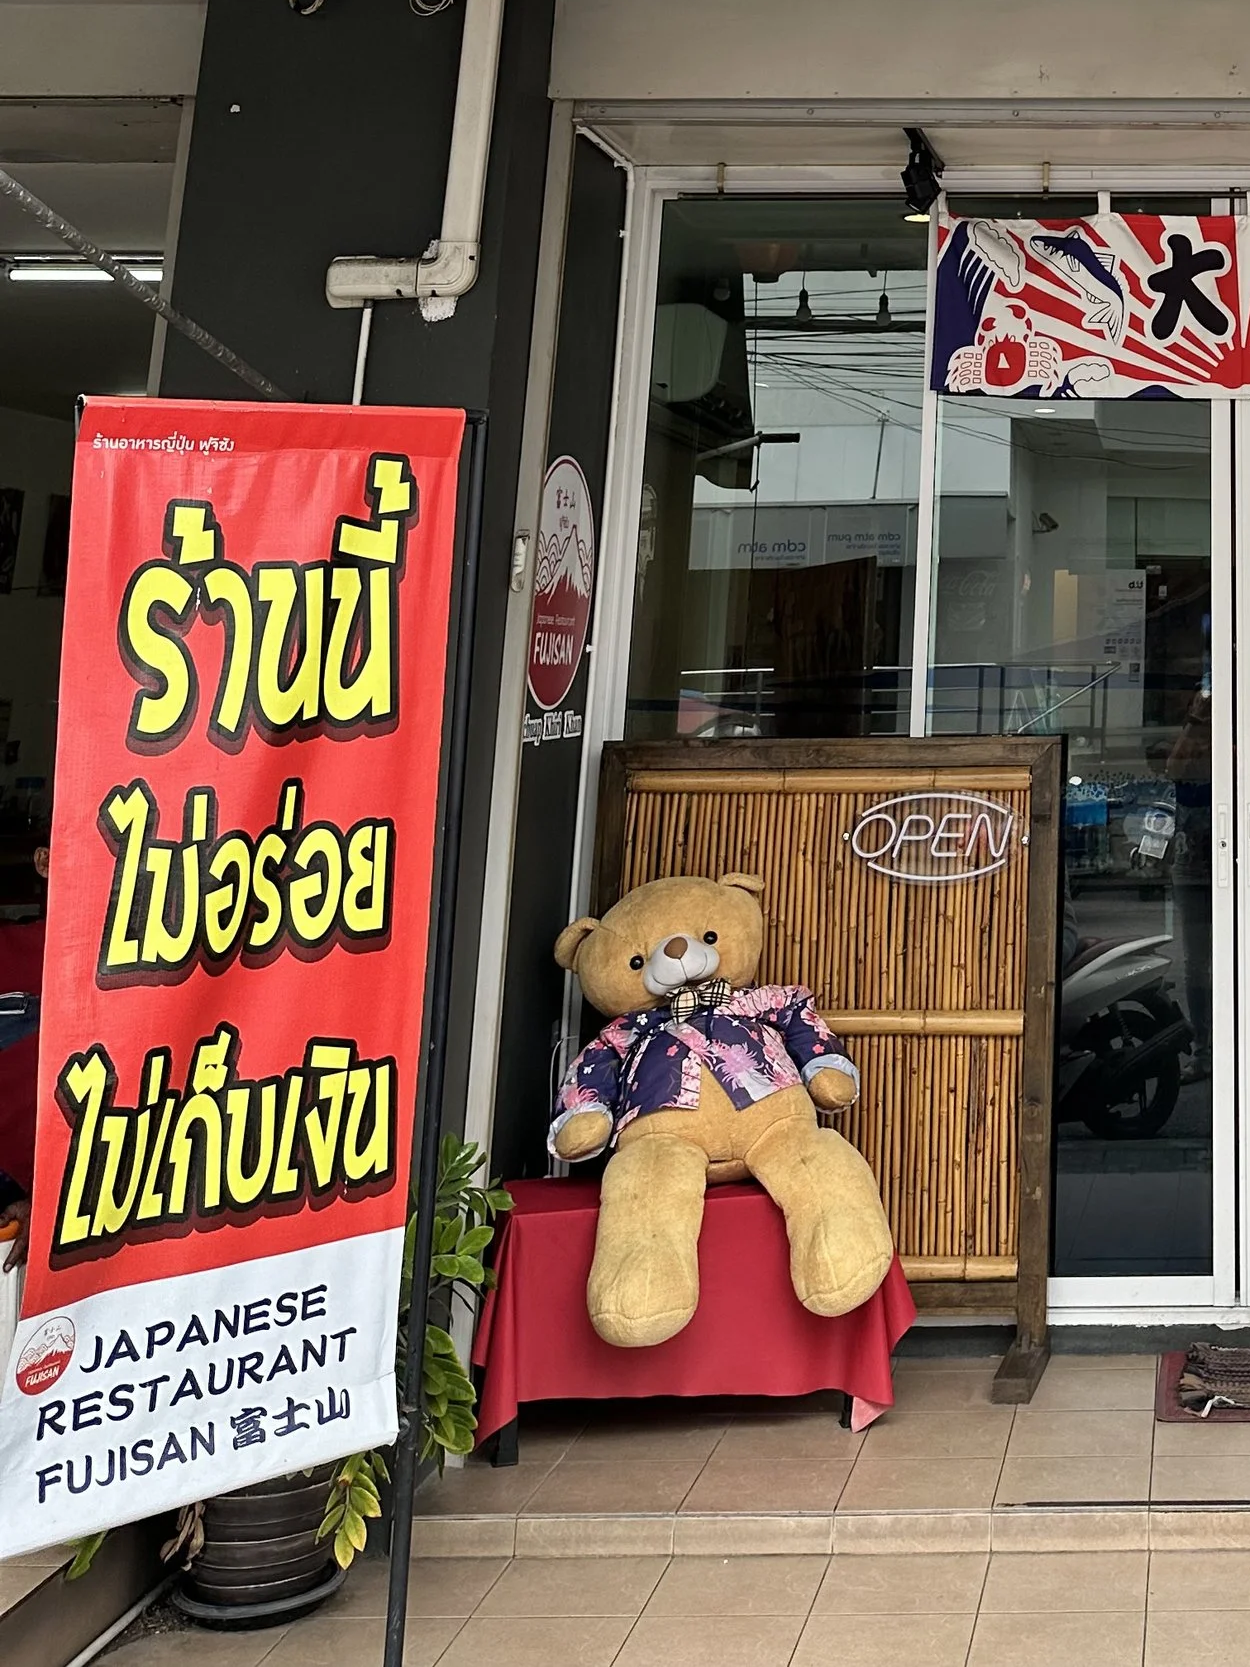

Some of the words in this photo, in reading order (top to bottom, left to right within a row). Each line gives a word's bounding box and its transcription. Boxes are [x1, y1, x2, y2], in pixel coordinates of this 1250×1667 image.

[93, 430, 195, 456] ร้านอาหารญี่ปุ่น
[199, 436, 235, 456] ฟูจิซัง
[124, 456, 413, 737] ร้านนี้
[533, 632, 574, 665] FUJISAN
[105, 784, 389, 968] ไม่อร่อย
[852, 813, 1014, 859] OPEN
[59, 1030, 390, 1245] ไม่เก็บเงิน
[25, 1365, 60, 1388] FUJISAN
[79, 1283, 328, 1375] JAPANESE
[36, 1326, 357, 1442] RESTAURANT
[35, 1420, 216, 1505] FUJISAN
[229, 1385, 352, 1451] 富士山
